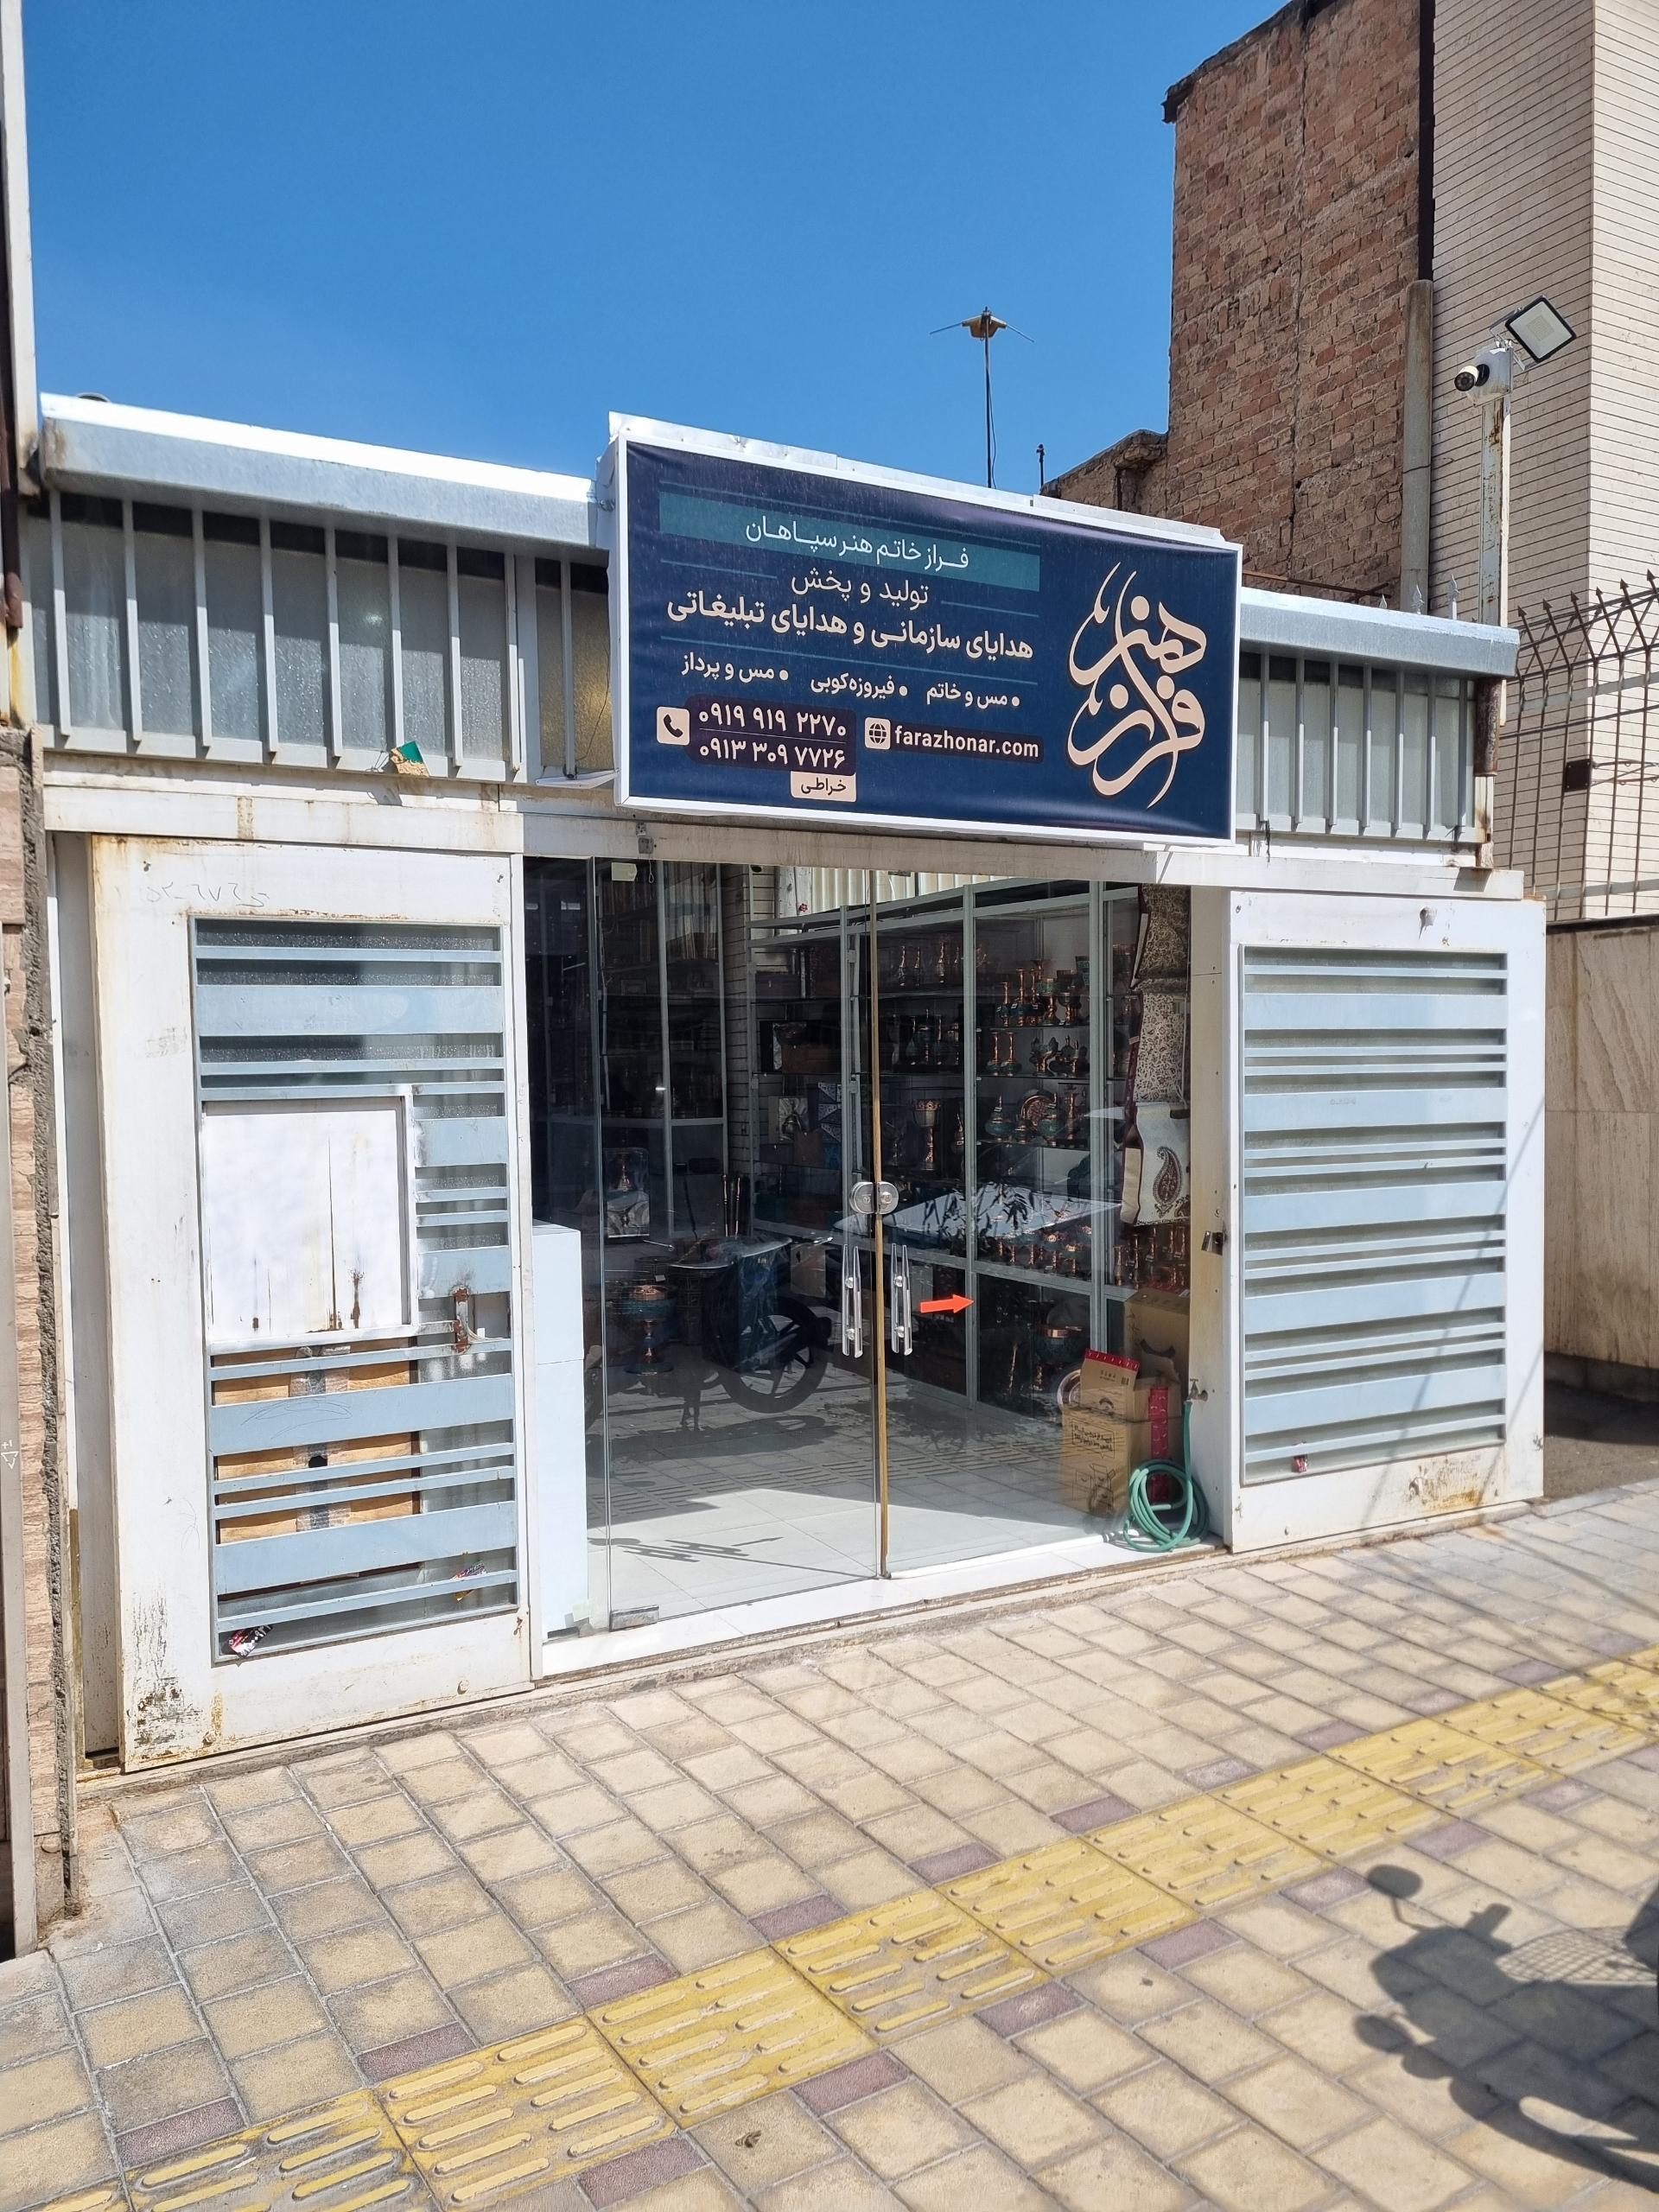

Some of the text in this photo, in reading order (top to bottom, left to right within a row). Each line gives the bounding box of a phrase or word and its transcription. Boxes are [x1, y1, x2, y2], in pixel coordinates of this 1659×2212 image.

[746, 515, 969, 572] فراز خاتم هنر سپاهان
[791, 567, 929, 611] تولید و پخش
[667, 590, 1034, 662] هدایای سازمانی و هدایای تبلیغاتی
[681, 652, 775, 683] مس و پرداز
[925, 682, 1008, 709] مس و خاتم
[698, 702, 847, 736] ۰۹۱۹ ۹۱۹ ۲۲۷۰
[699, 737, 845, 769] ۰۹۱۳ ۳۰۹ ۷۷۲۶
[894, 725, 1039, 758] farazhonar.com
[800, 776, 847, 795] خراطی
